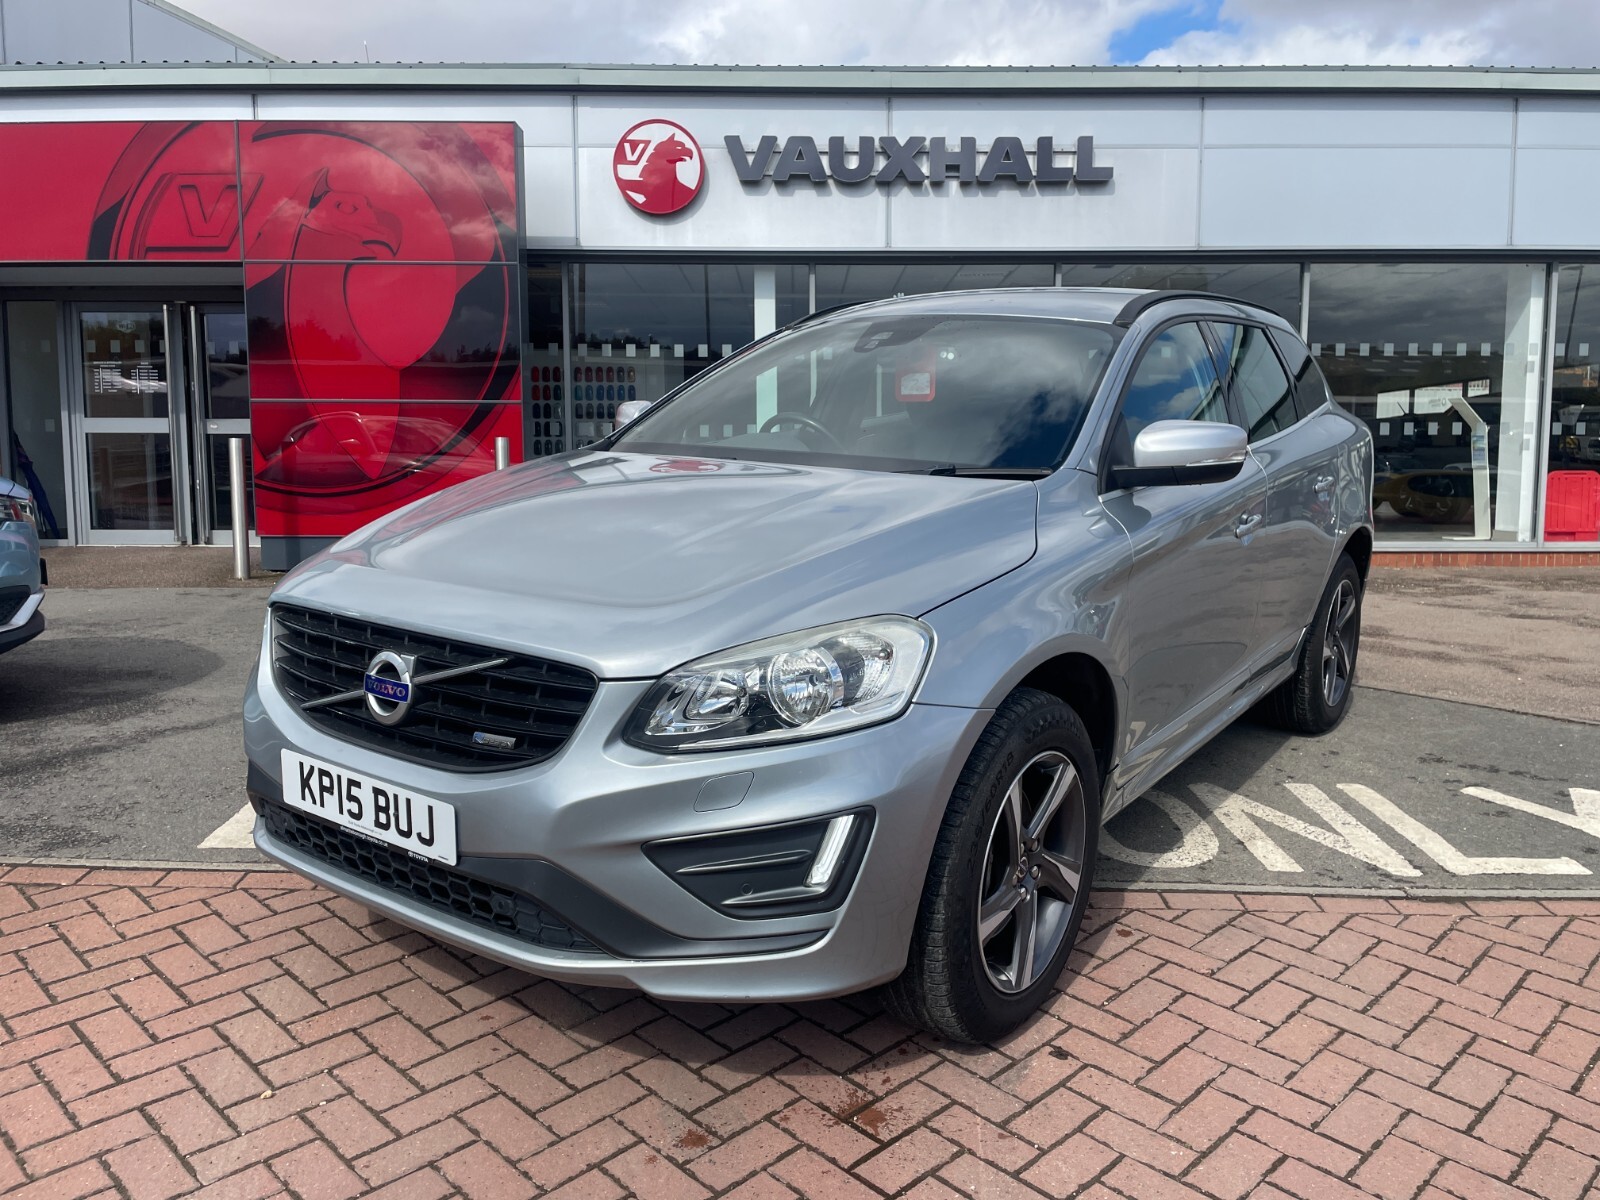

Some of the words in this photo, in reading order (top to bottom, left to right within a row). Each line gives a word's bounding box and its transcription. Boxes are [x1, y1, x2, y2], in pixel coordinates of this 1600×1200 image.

[623, 142, 645, 161] V
[723, 135, 1114, 182] VAUXHALL
[365, 678, 406, 698] VOLVO
[299, 761, 364, 822] KP15
[372, 786, 435, 847] BUJ
